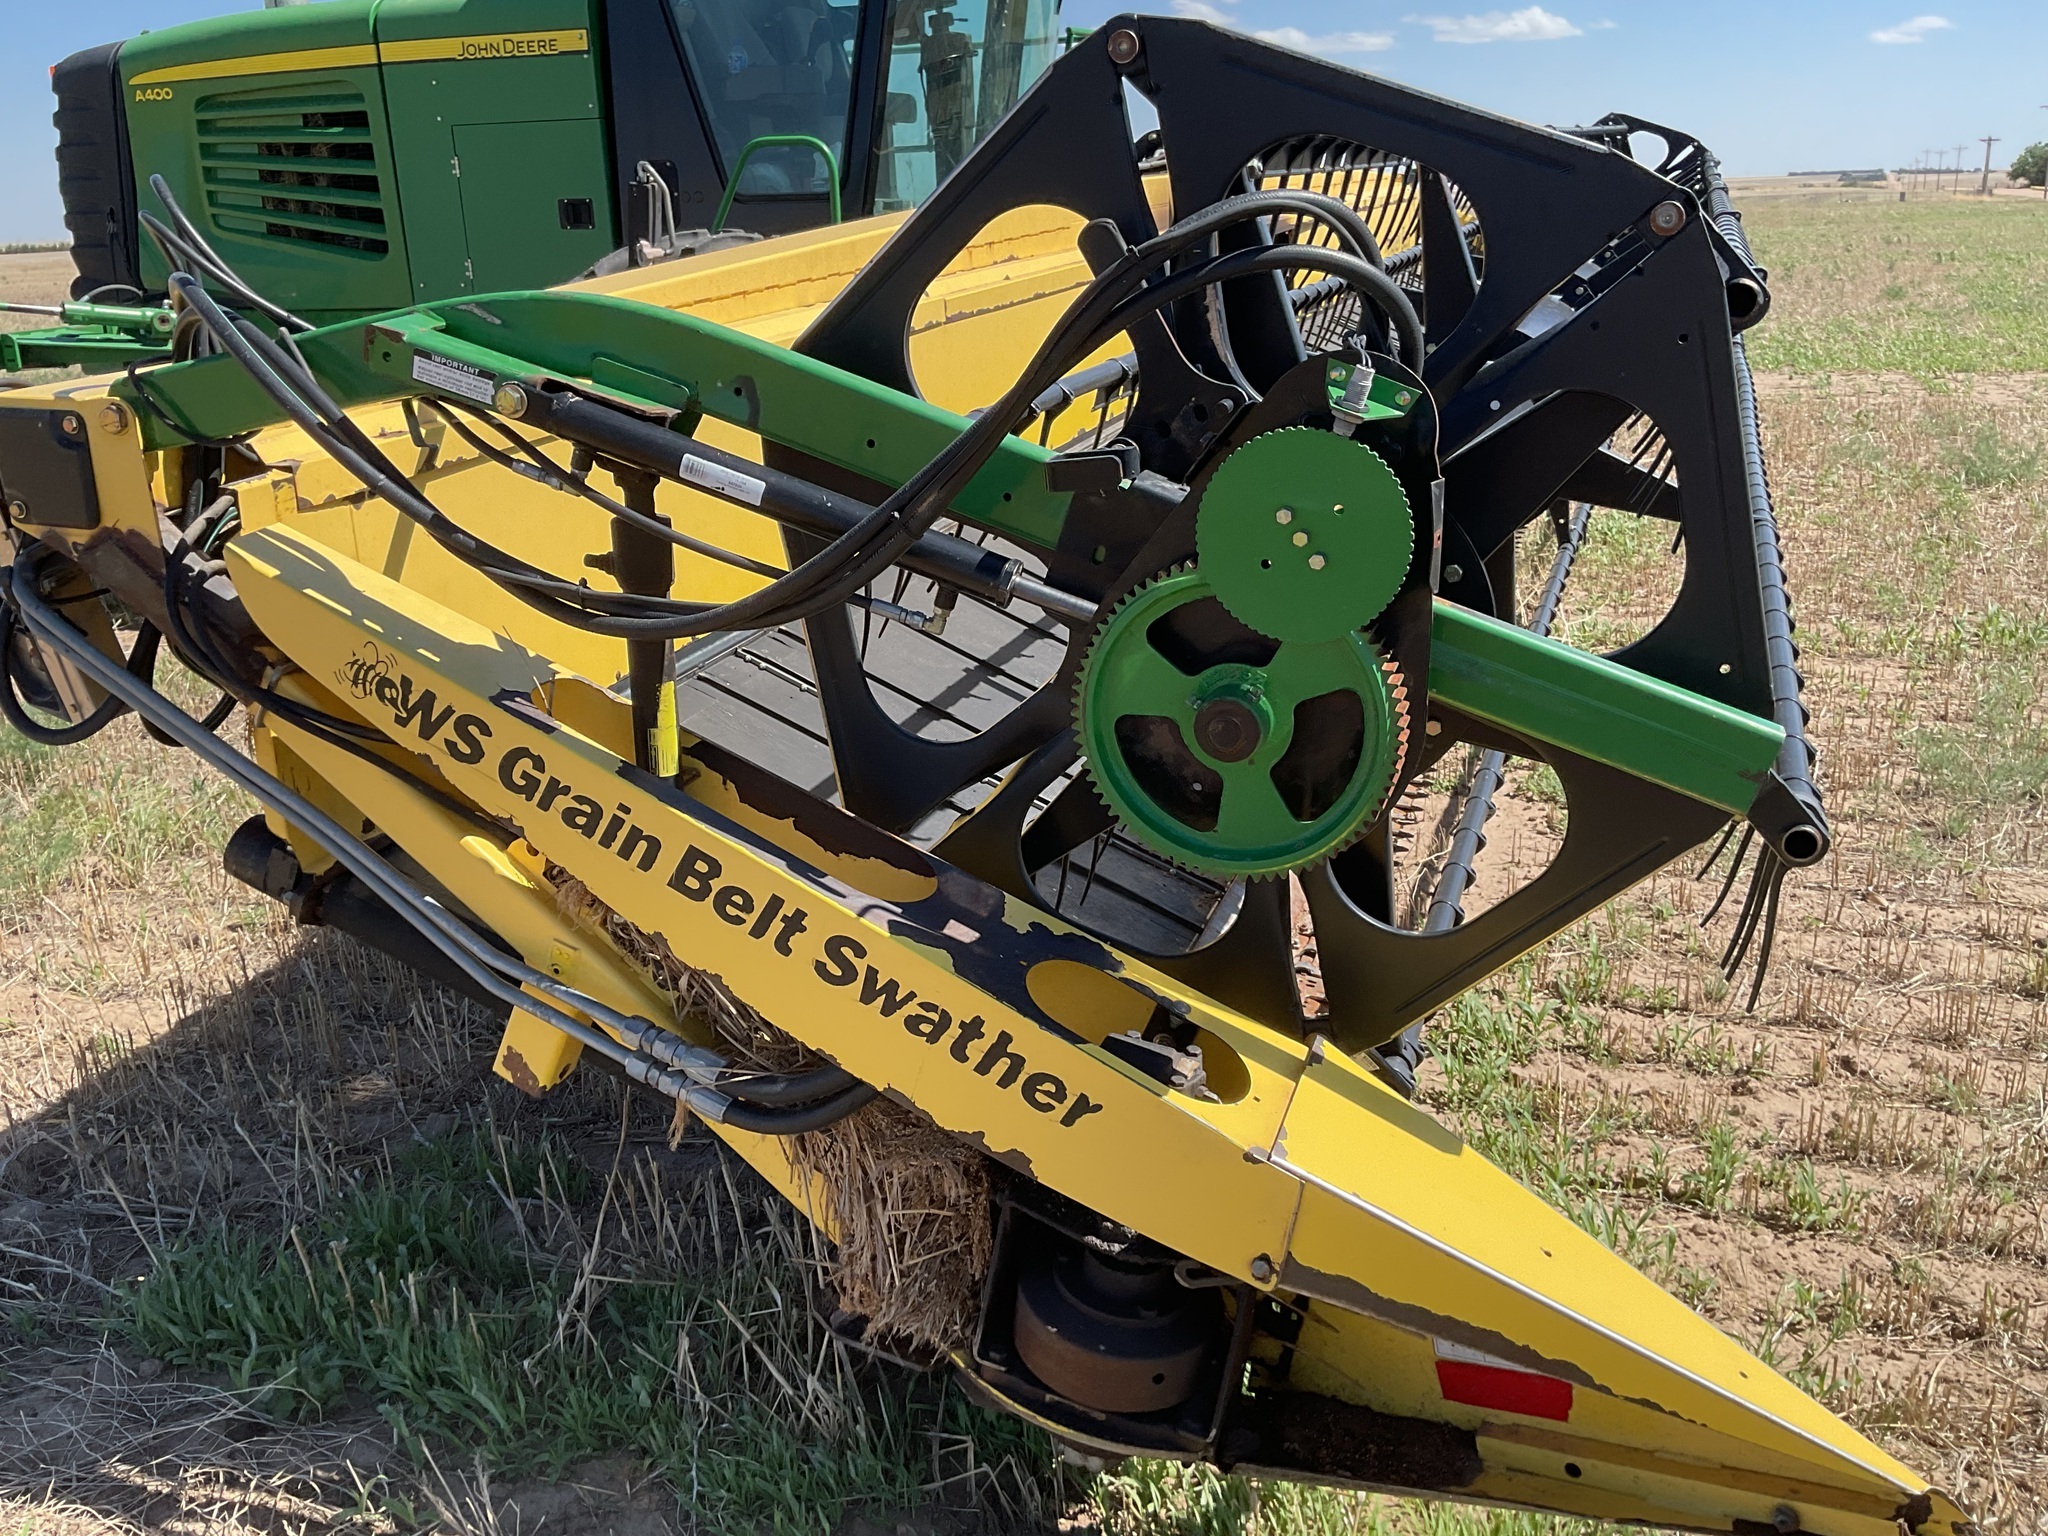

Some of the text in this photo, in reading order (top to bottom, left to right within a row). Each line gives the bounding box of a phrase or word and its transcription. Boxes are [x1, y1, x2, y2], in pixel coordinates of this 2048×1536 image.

[457, 38, 558, 57] JOHN DEERE
[135, 87, 173, 102] A400
[431, 353, 480, 376] IMPORTANT
[394, 673, 1104, 1128] WS Grain Belt Swather
